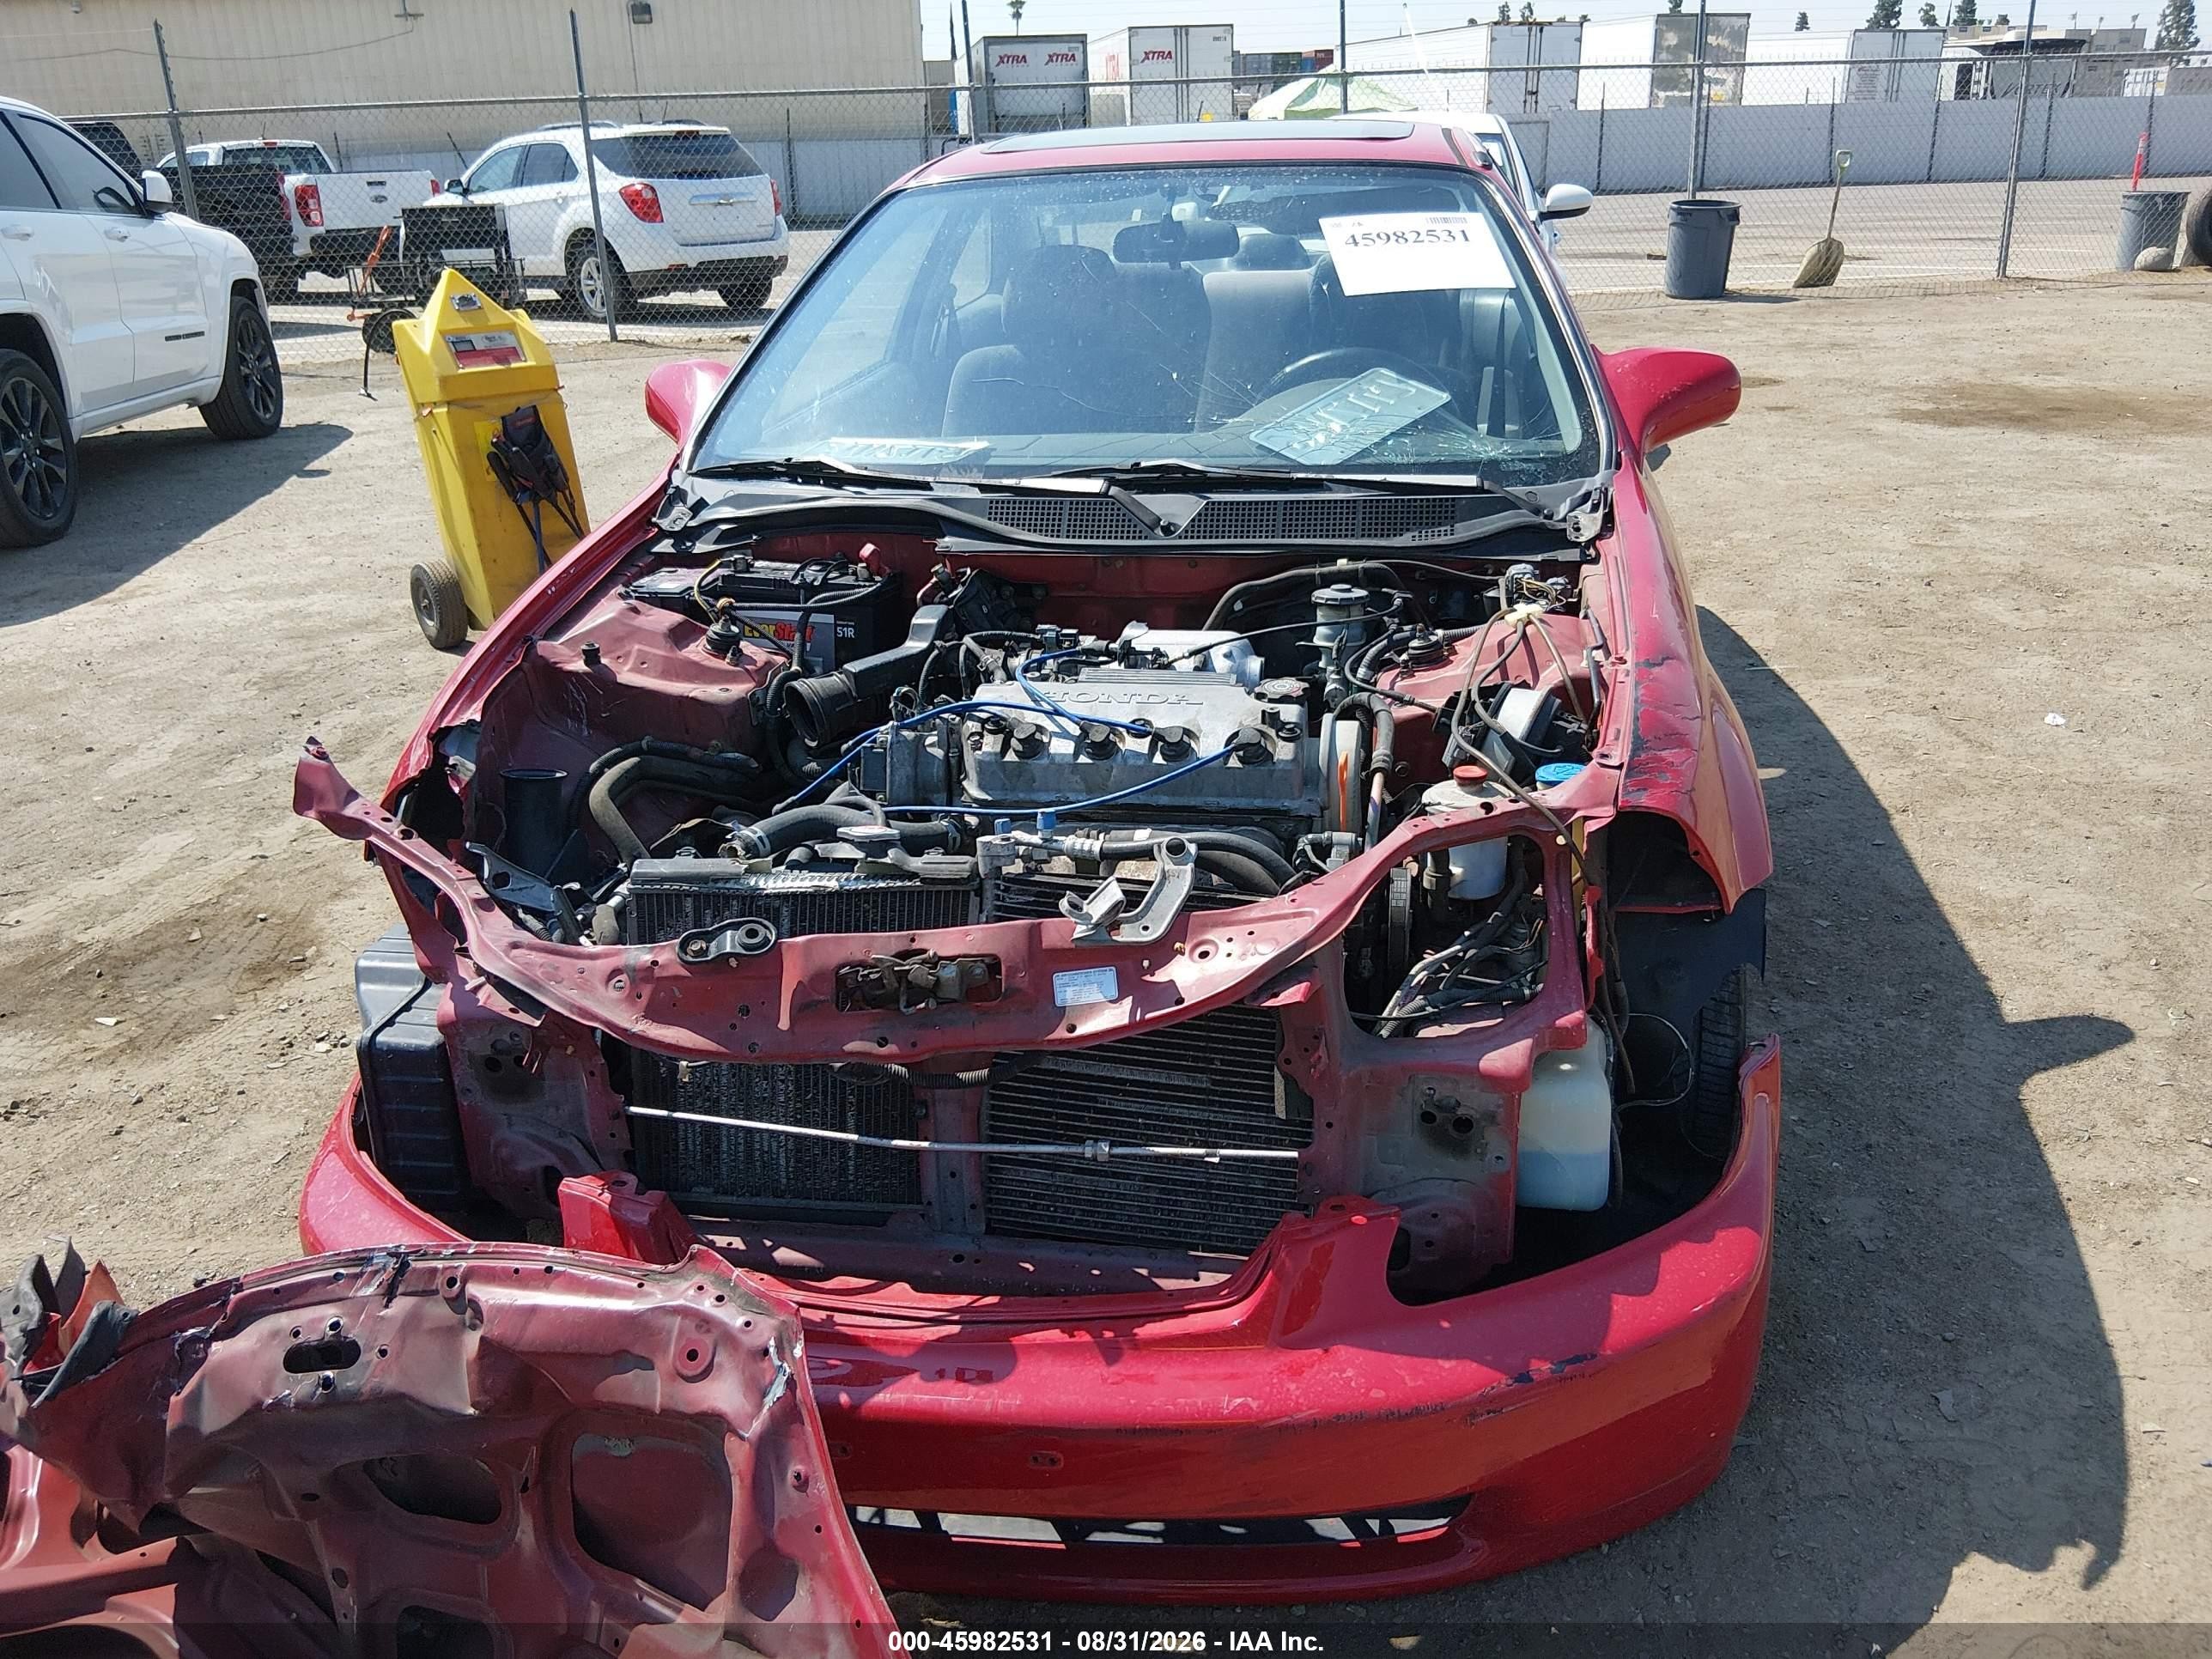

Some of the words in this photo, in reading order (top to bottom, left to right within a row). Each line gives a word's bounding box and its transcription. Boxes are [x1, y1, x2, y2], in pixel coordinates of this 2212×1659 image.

[995, 53, 1028, 68] XTRA
[1044, 52, 1077, 66] XTRA
[1140, 50, 1173, 64] XTRA
[1345, 228, 1471, 247] 45982531
[744, 622, 815, 641] EerStat
[836, 626, 855, 639] 51R
